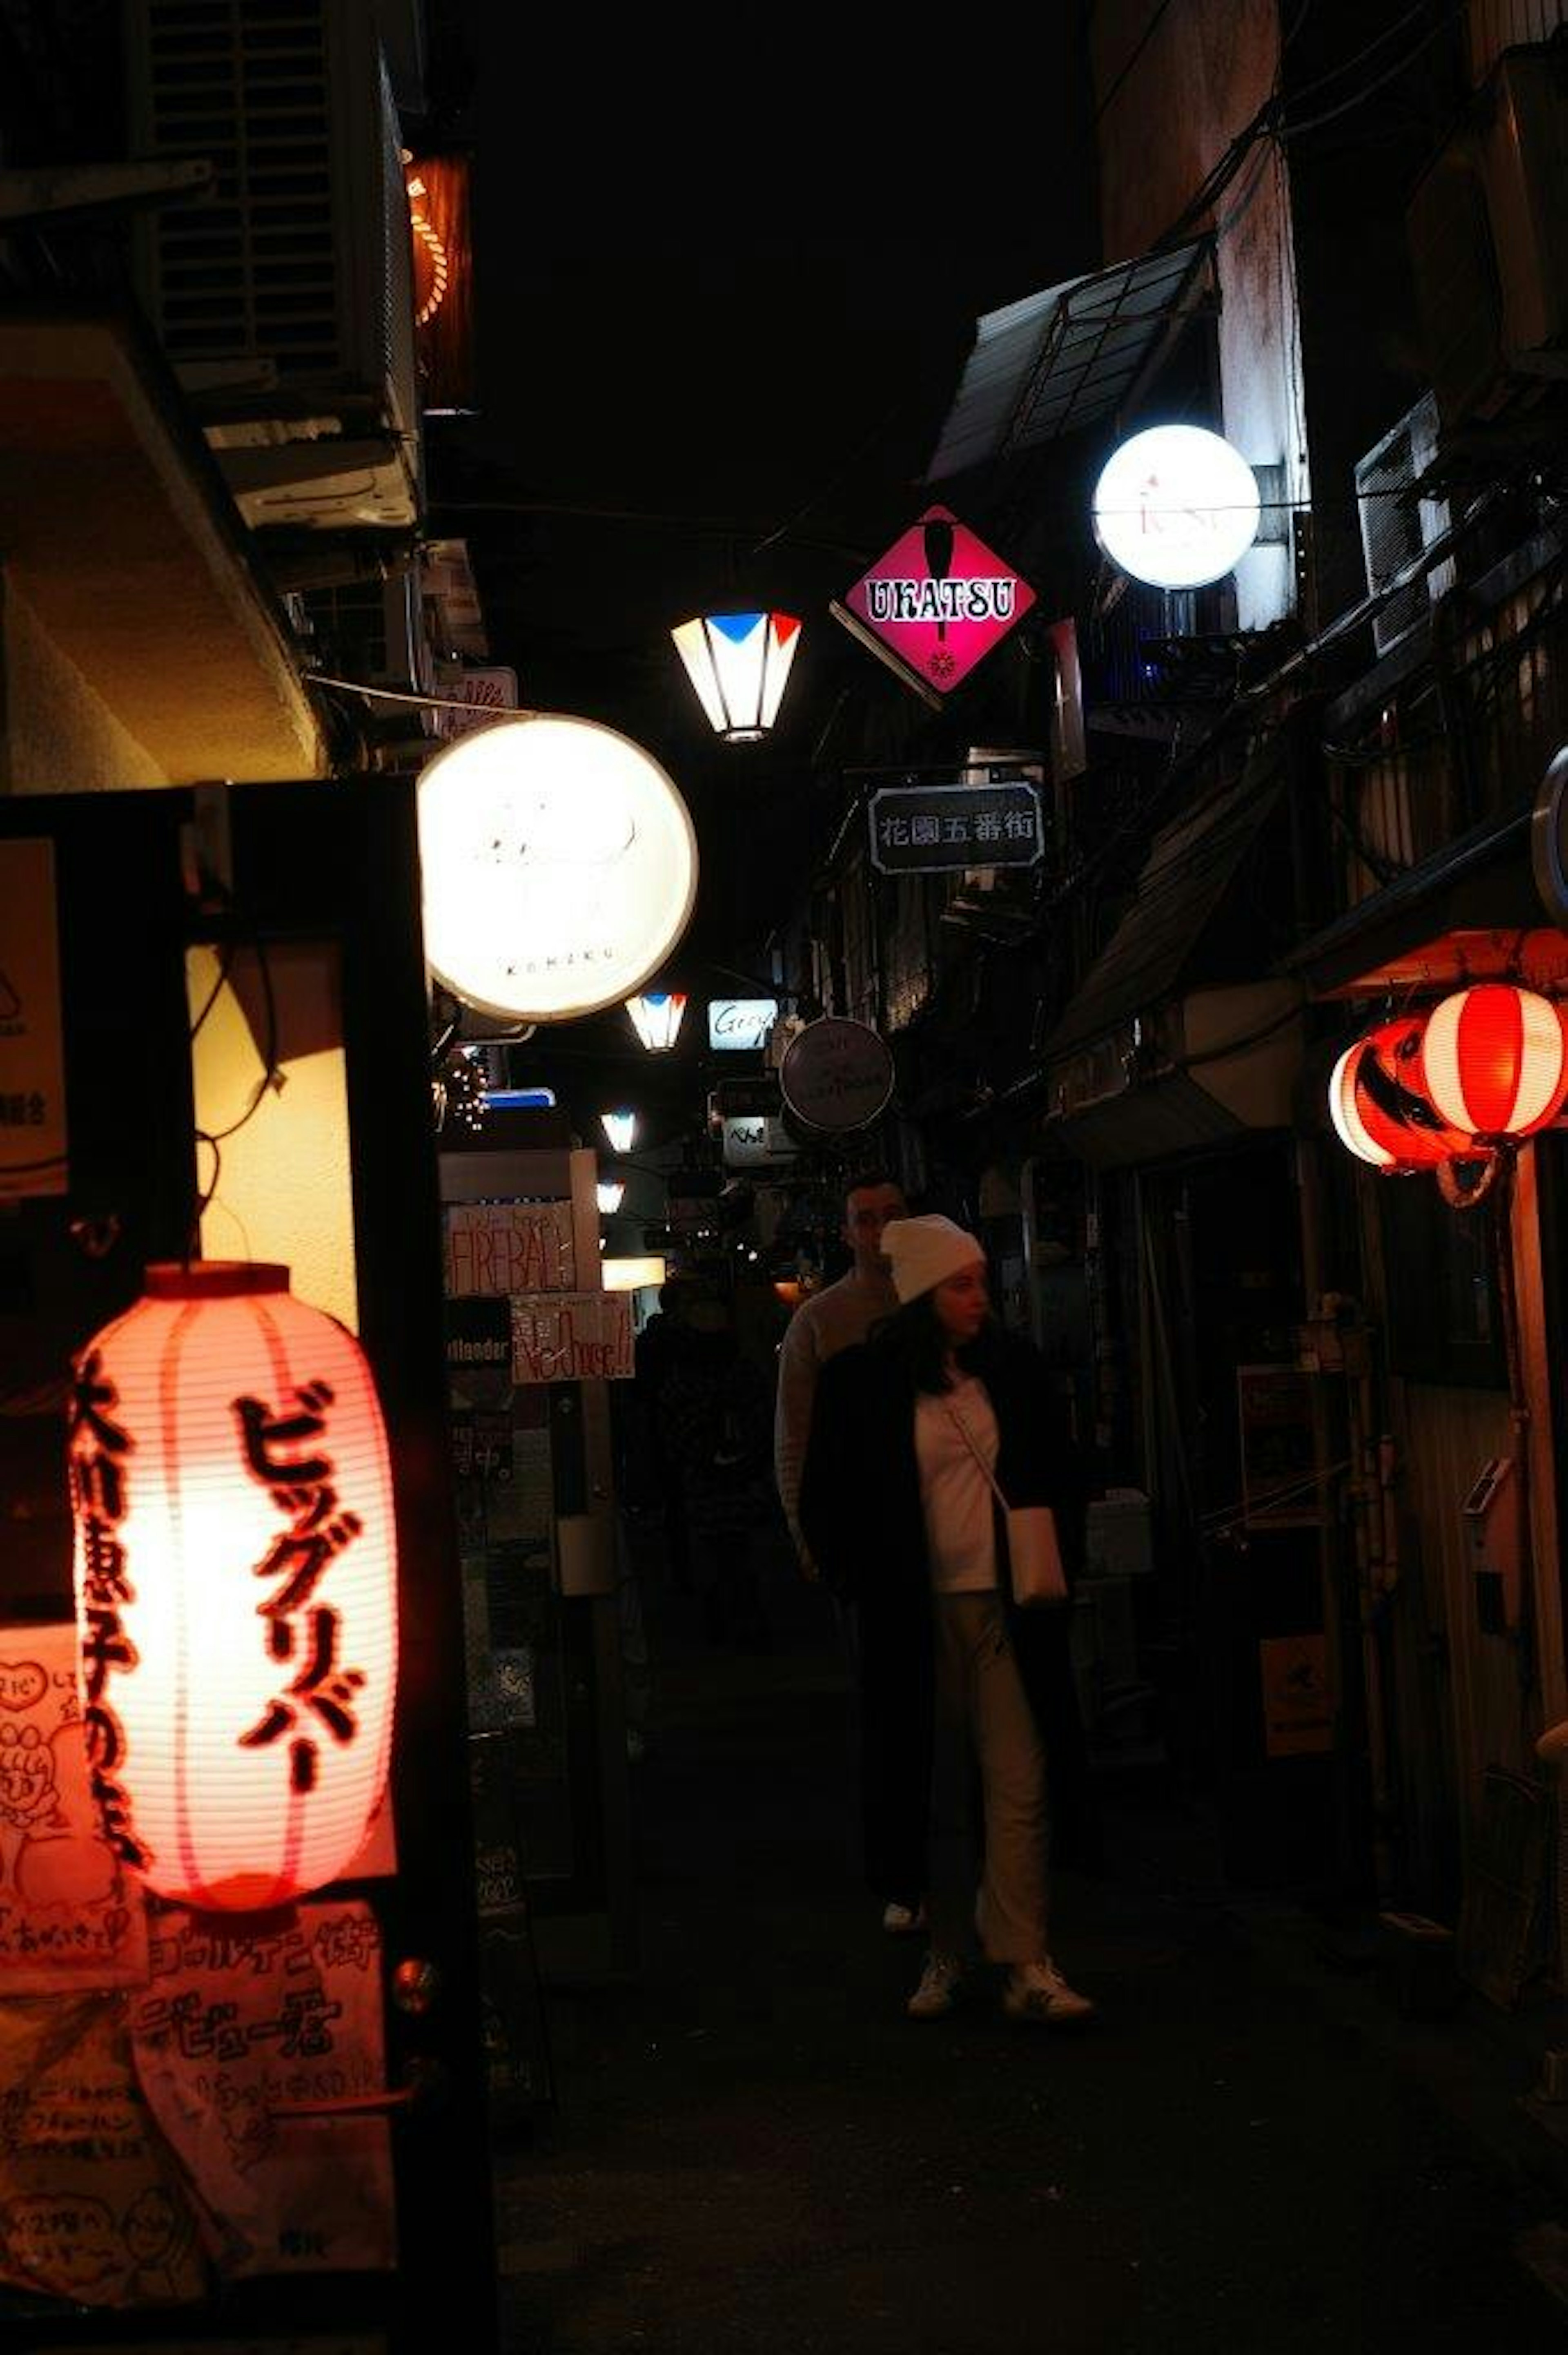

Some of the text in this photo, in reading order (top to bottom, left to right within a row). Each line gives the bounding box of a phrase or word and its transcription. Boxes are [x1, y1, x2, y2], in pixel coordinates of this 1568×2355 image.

[865, 578, 1017, 622] UKATSU
[879, 810, 1036, 847] 花園五番街
[232, 1379, 366, 1793] ビッグリバー
